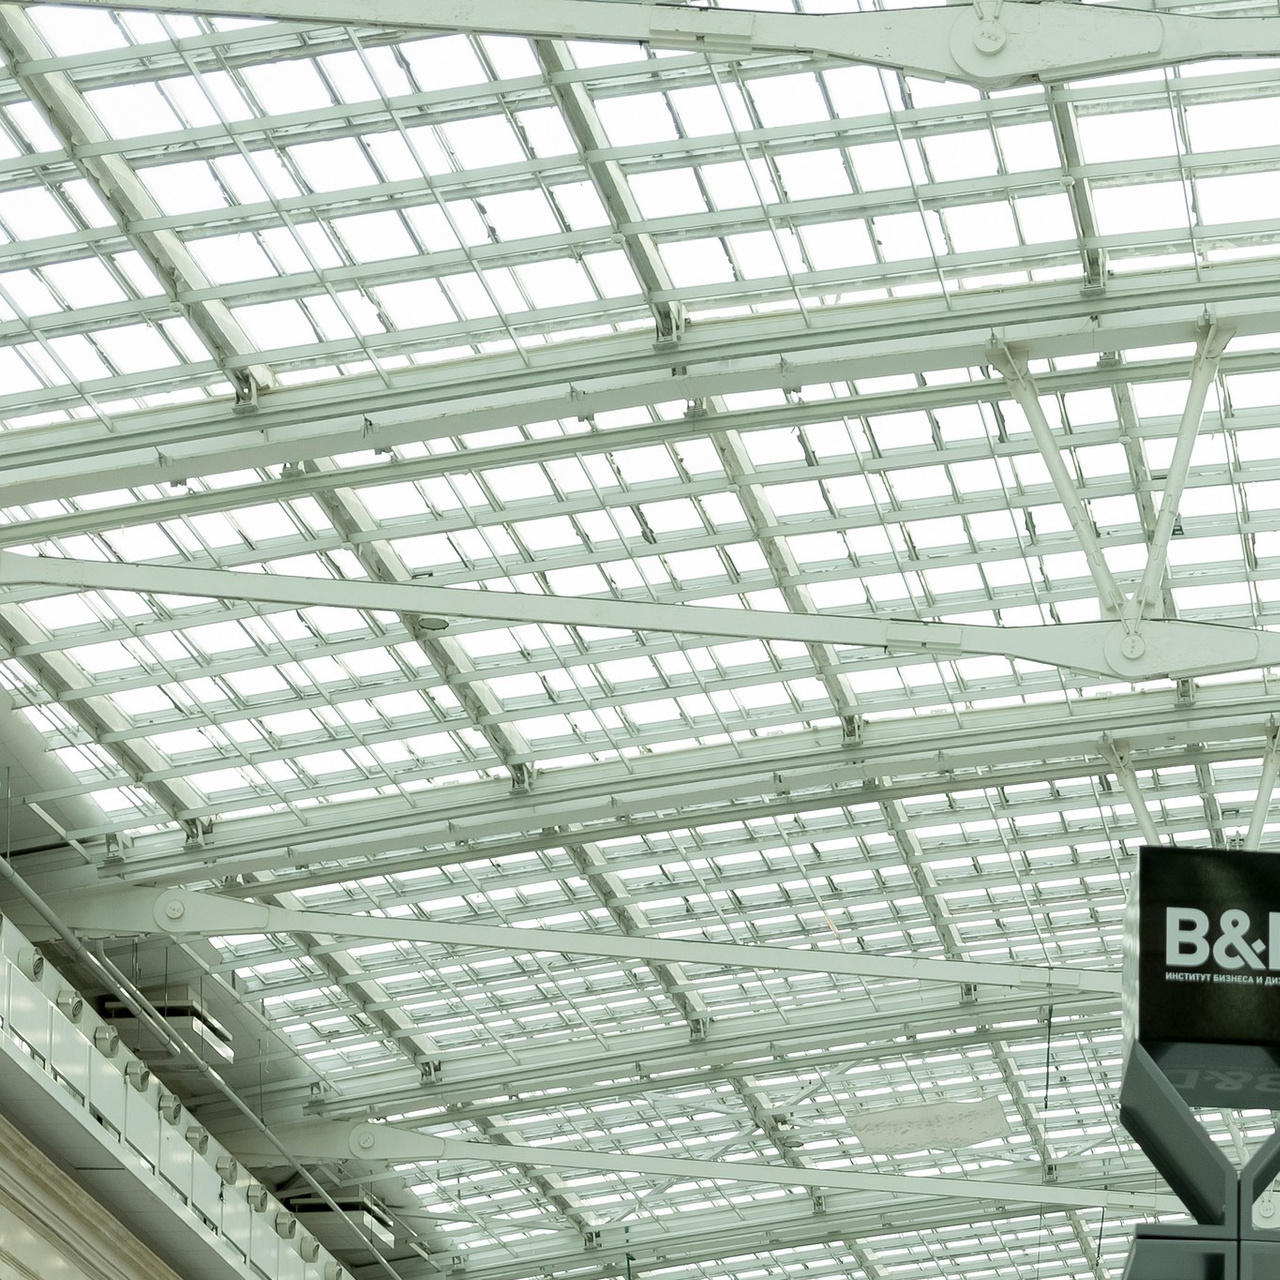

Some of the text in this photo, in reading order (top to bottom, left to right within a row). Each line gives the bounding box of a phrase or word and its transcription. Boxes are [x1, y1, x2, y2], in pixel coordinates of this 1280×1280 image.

[1165, 971, 1211, 981] ИНСТИТУТ
[1213, 973, 1254, 984] БИЗНЕСА
[1256, 976, 1263, 984] И
